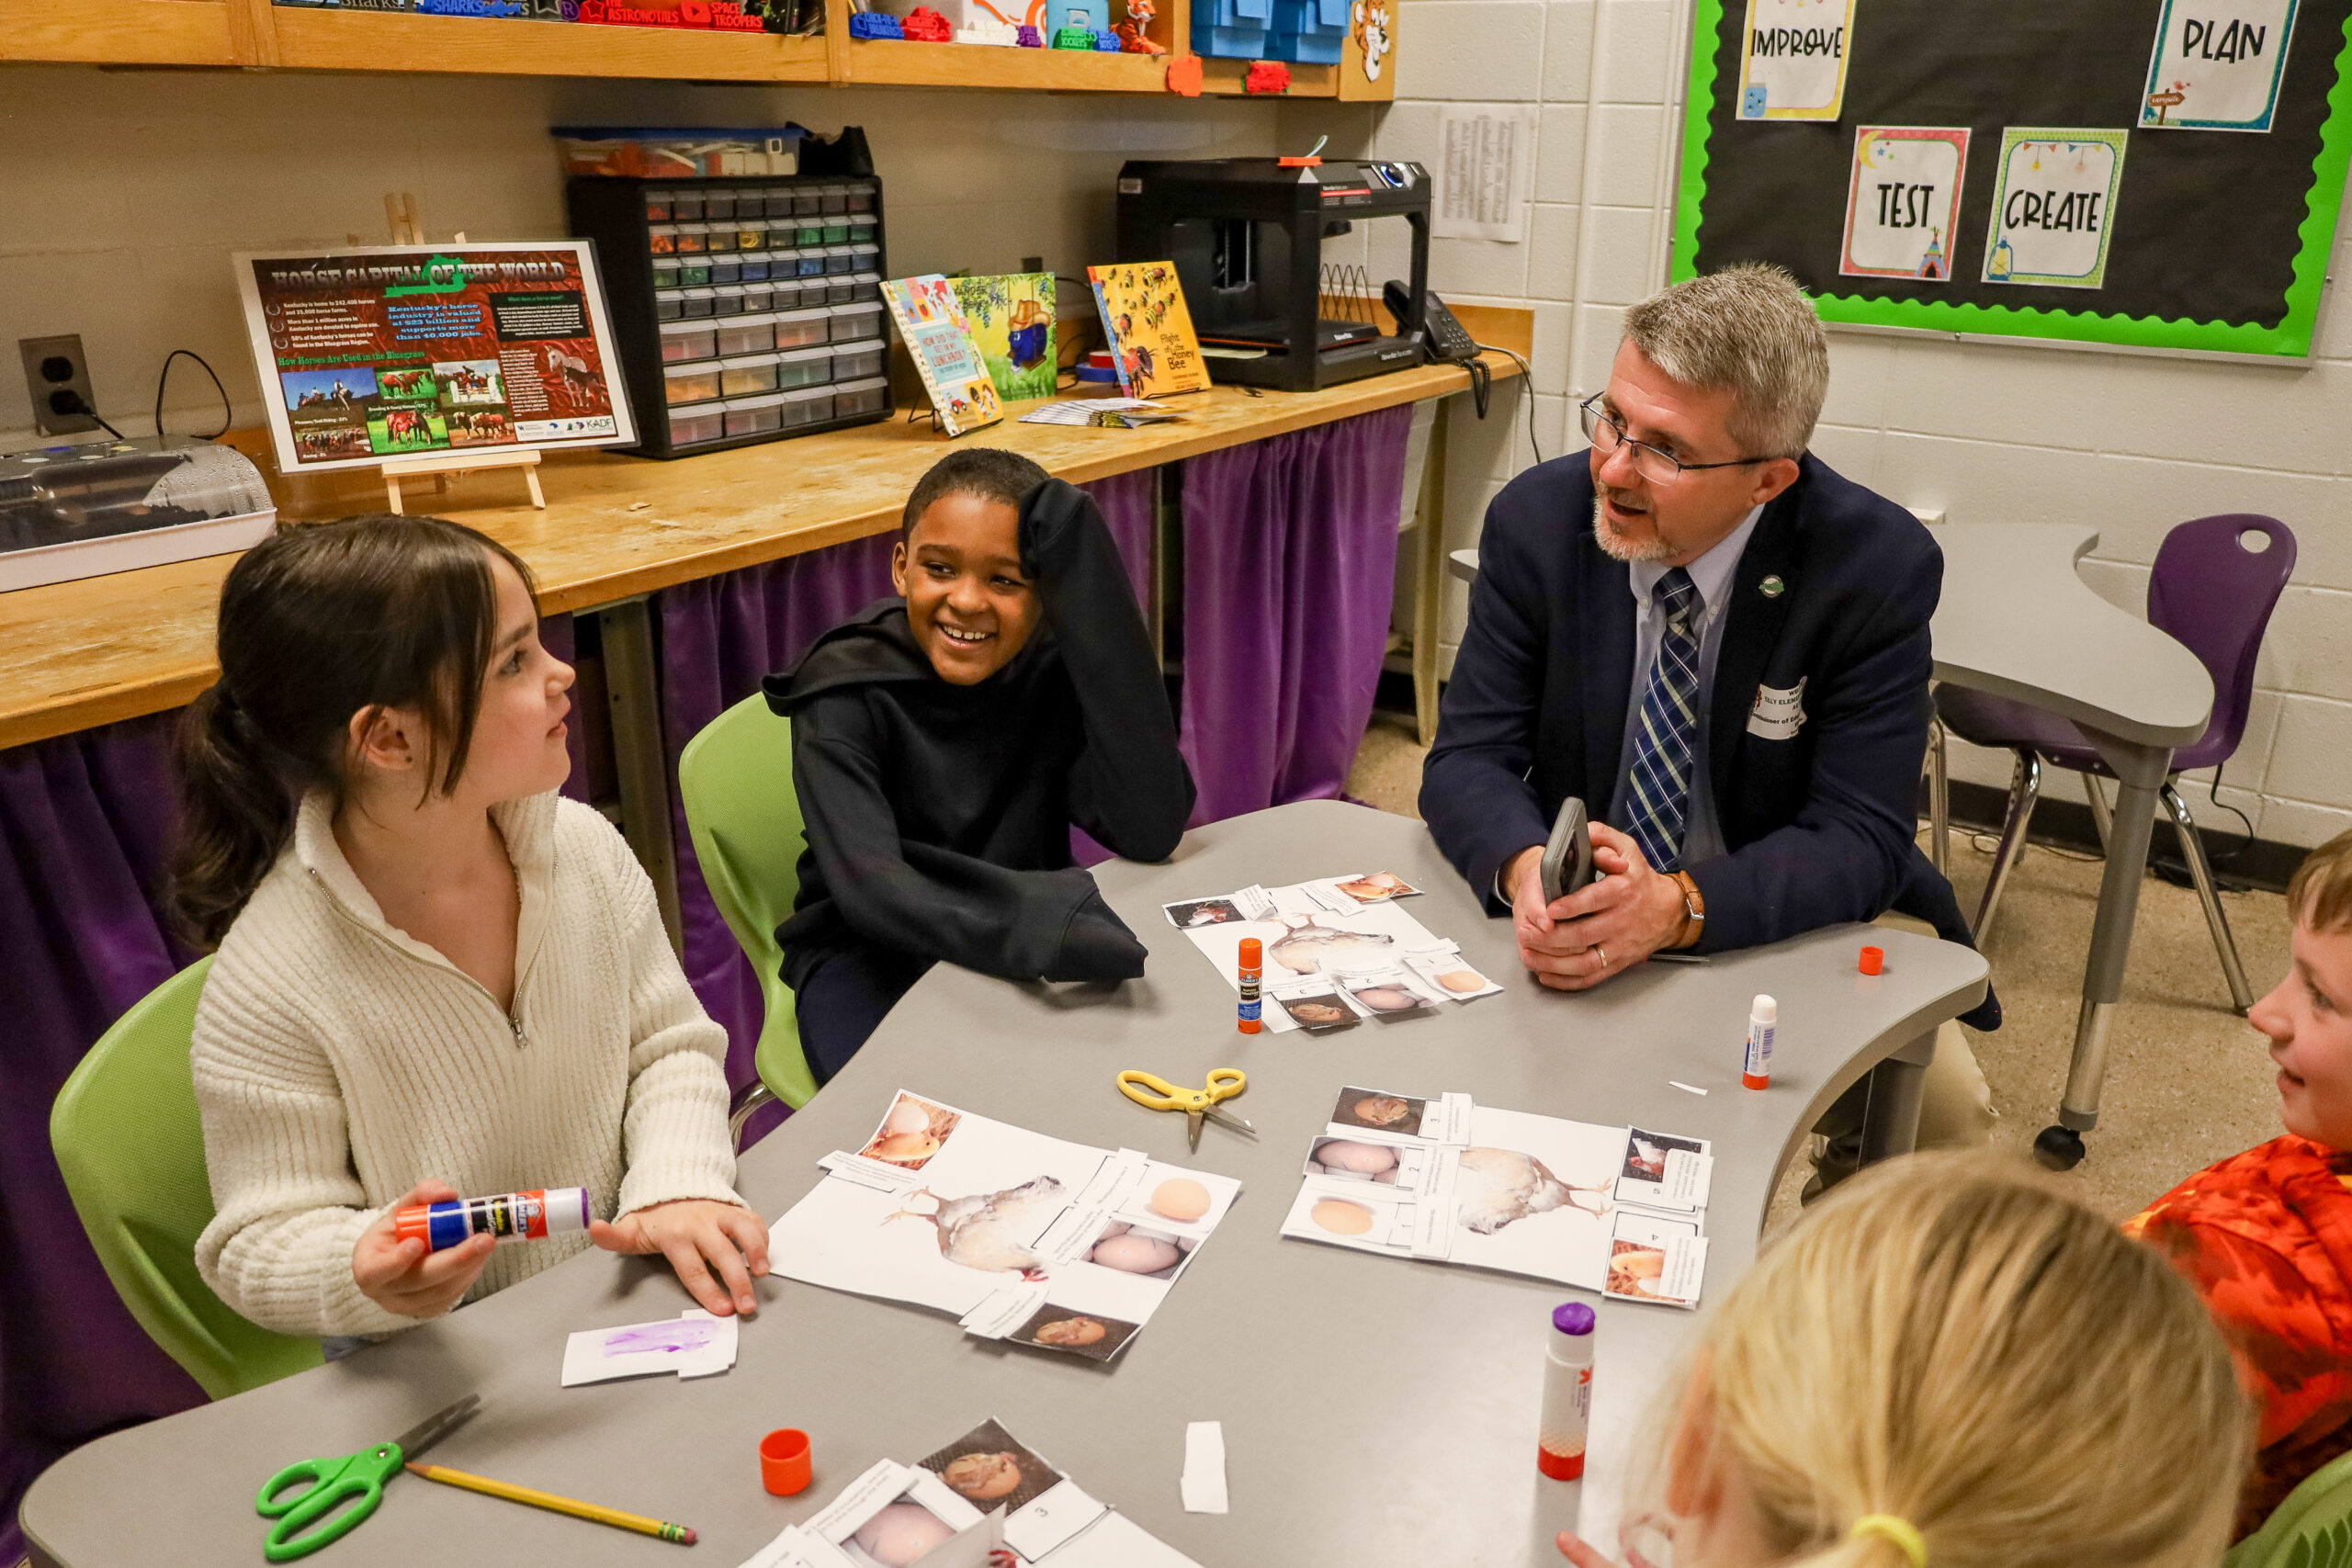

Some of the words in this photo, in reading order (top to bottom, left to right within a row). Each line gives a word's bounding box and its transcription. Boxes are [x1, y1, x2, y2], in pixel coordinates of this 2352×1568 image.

[434, 0, 484, 14] SHARKS
[715, 14, 763, 28] TROOPERS
[1750, 27, 1842, 58] IMPROVE
[2183, 18, 2265, 63] PLAN
[1878, 183, 1934, 229] TEST
[2005, 189, 2101, 233] CREATE
[271, 269, 342, 288] HORSE
[345, 265, 431, 287] CAPITAL
[431, 264, 455, 286] OF
[457, 262, 497, 284] THE
[499, 261, 566, 282] WORLD
[388, 304, 447, 312] Kentucky's
[1159, 333, 1181, 345] Flight
[277, 356, 296, 367] How
[298, 355, 327, 365] Horses
[327, 355, 341, 363] Are
[343, 353, 361, 363] Used
[372, 353, 385, 361] the
[386, 351, 425, 361] Bluegrass
[1170, 348, 1194, 360] Honey
[1168, 357, 1186, 370] Bee
[586, 418, 611, 428] KADF
[1035, 1506, 1049, 1517] 3
